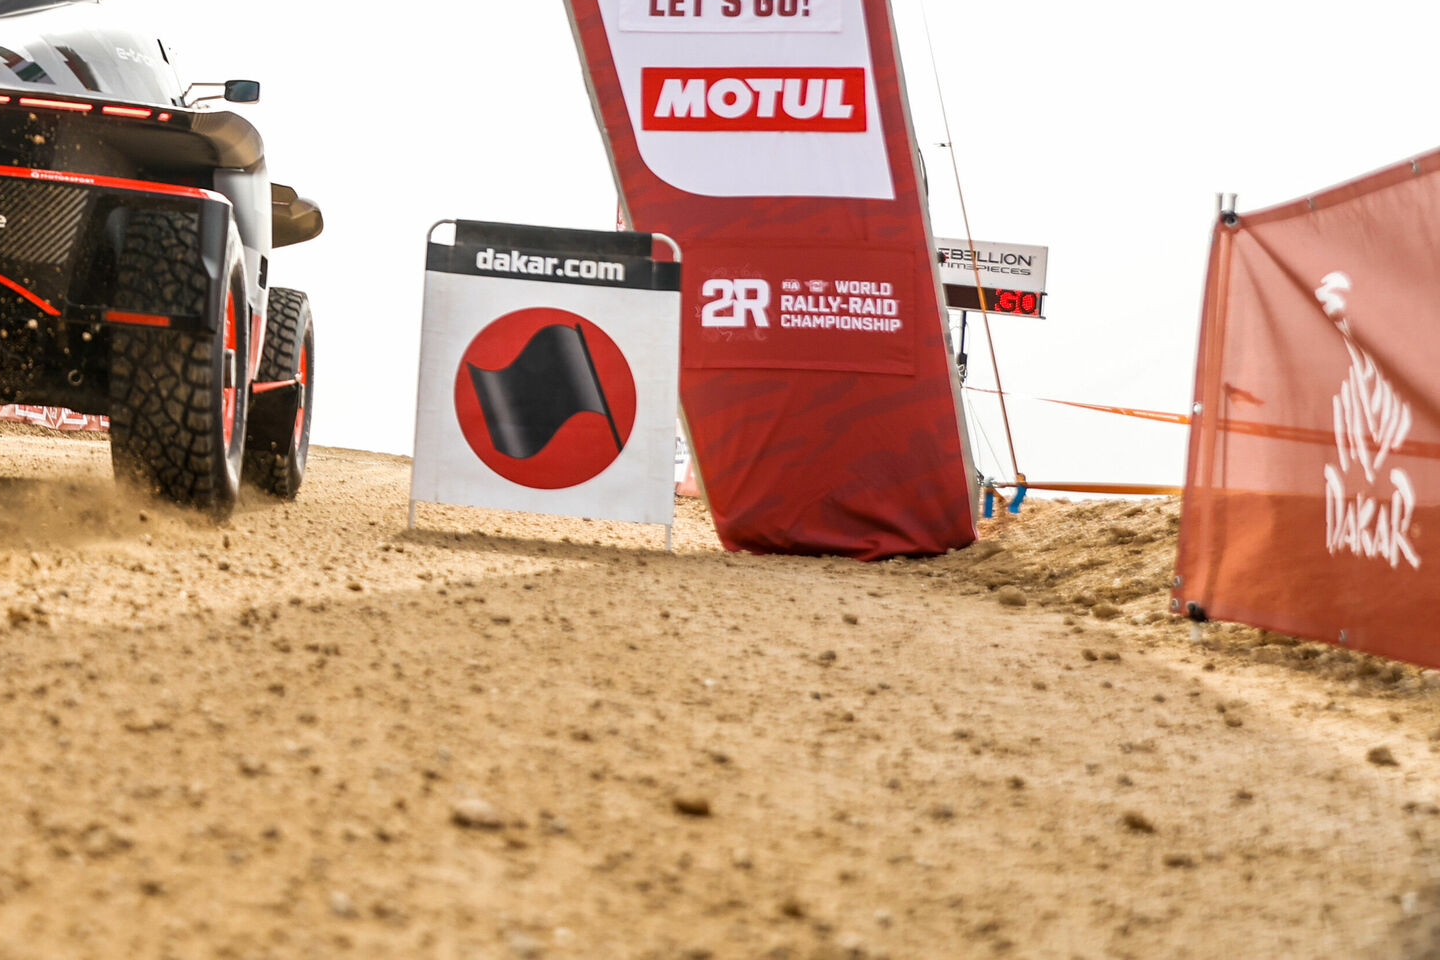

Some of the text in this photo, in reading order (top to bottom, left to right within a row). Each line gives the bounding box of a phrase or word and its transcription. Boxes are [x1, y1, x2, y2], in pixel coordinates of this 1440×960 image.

[653, 77, 854, 119] MOTUL
[475, 248, 626, 282] dakar.com
[834, 280, 892, 296] WORLD
[780, 295, 898, 316] RALLY-RAID
[780, 314, 903, 332] CHAMPIONSHIP
[1324, 463, 1421, 569] DAKAR
